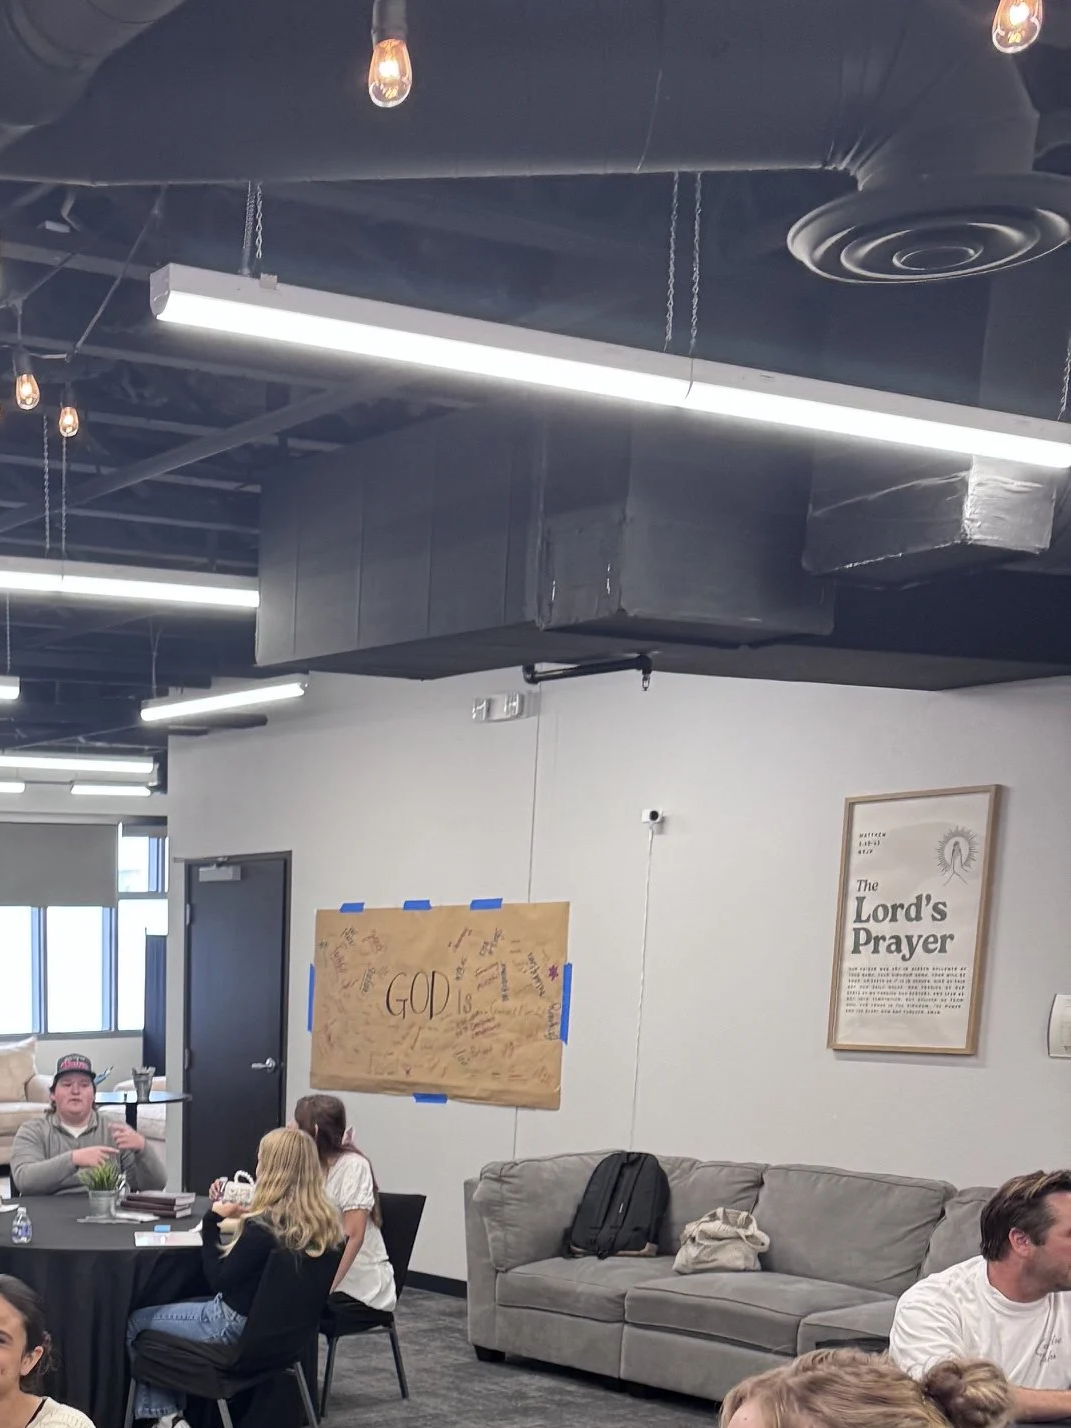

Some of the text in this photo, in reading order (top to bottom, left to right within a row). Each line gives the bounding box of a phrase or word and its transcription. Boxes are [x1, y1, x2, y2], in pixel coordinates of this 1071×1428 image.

[857, 879, 879, 892] The
[853, 893, 947, 923] Lord's
[851, 927, 955, 962] Prayer
[386, 970, 450, 1020] GOD
